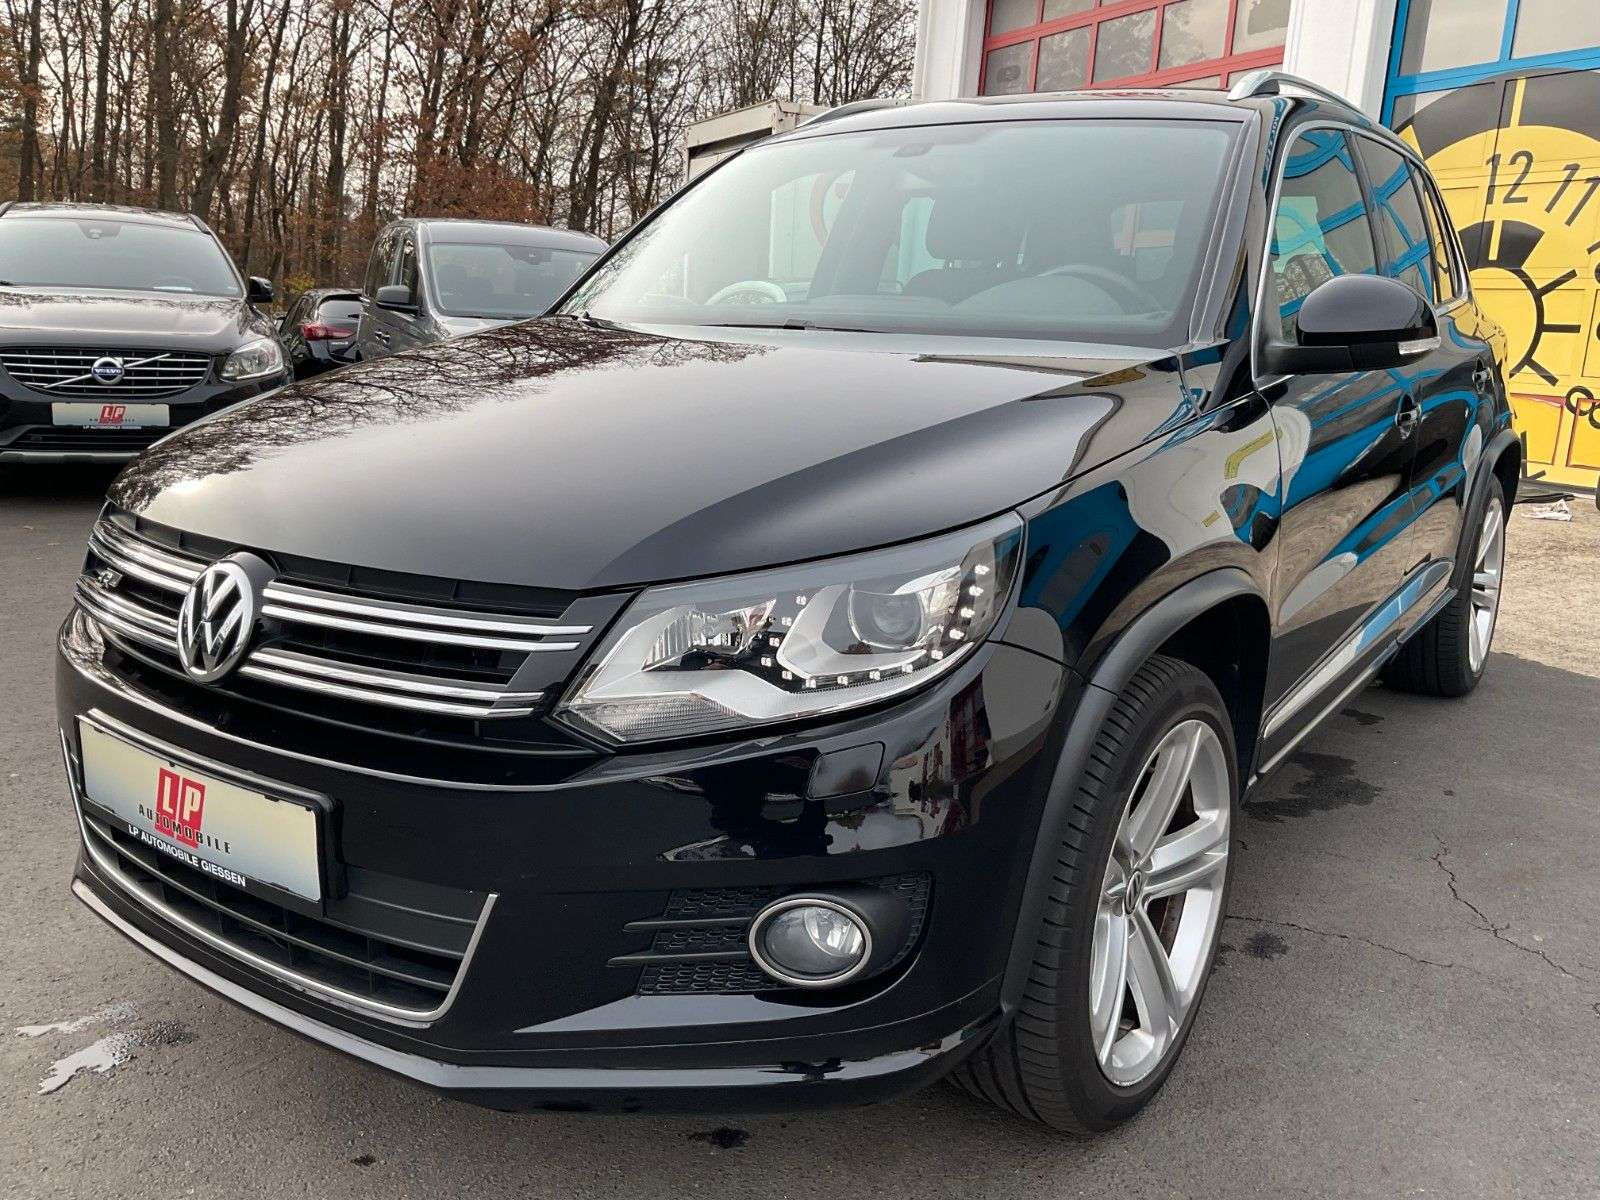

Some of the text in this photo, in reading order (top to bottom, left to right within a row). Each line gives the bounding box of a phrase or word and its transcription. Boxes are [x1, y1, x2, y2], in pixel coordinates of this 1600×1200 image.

[1485, 150, 1534, 205] 12
[94, 367, 122, 375] VOLVO
[161, 775, 202, 821] LP
[138, 803, 232, 855] AUTOMOBILE
[128, 824, 246, 887] LP AUTOMOBILE GIESSEN
